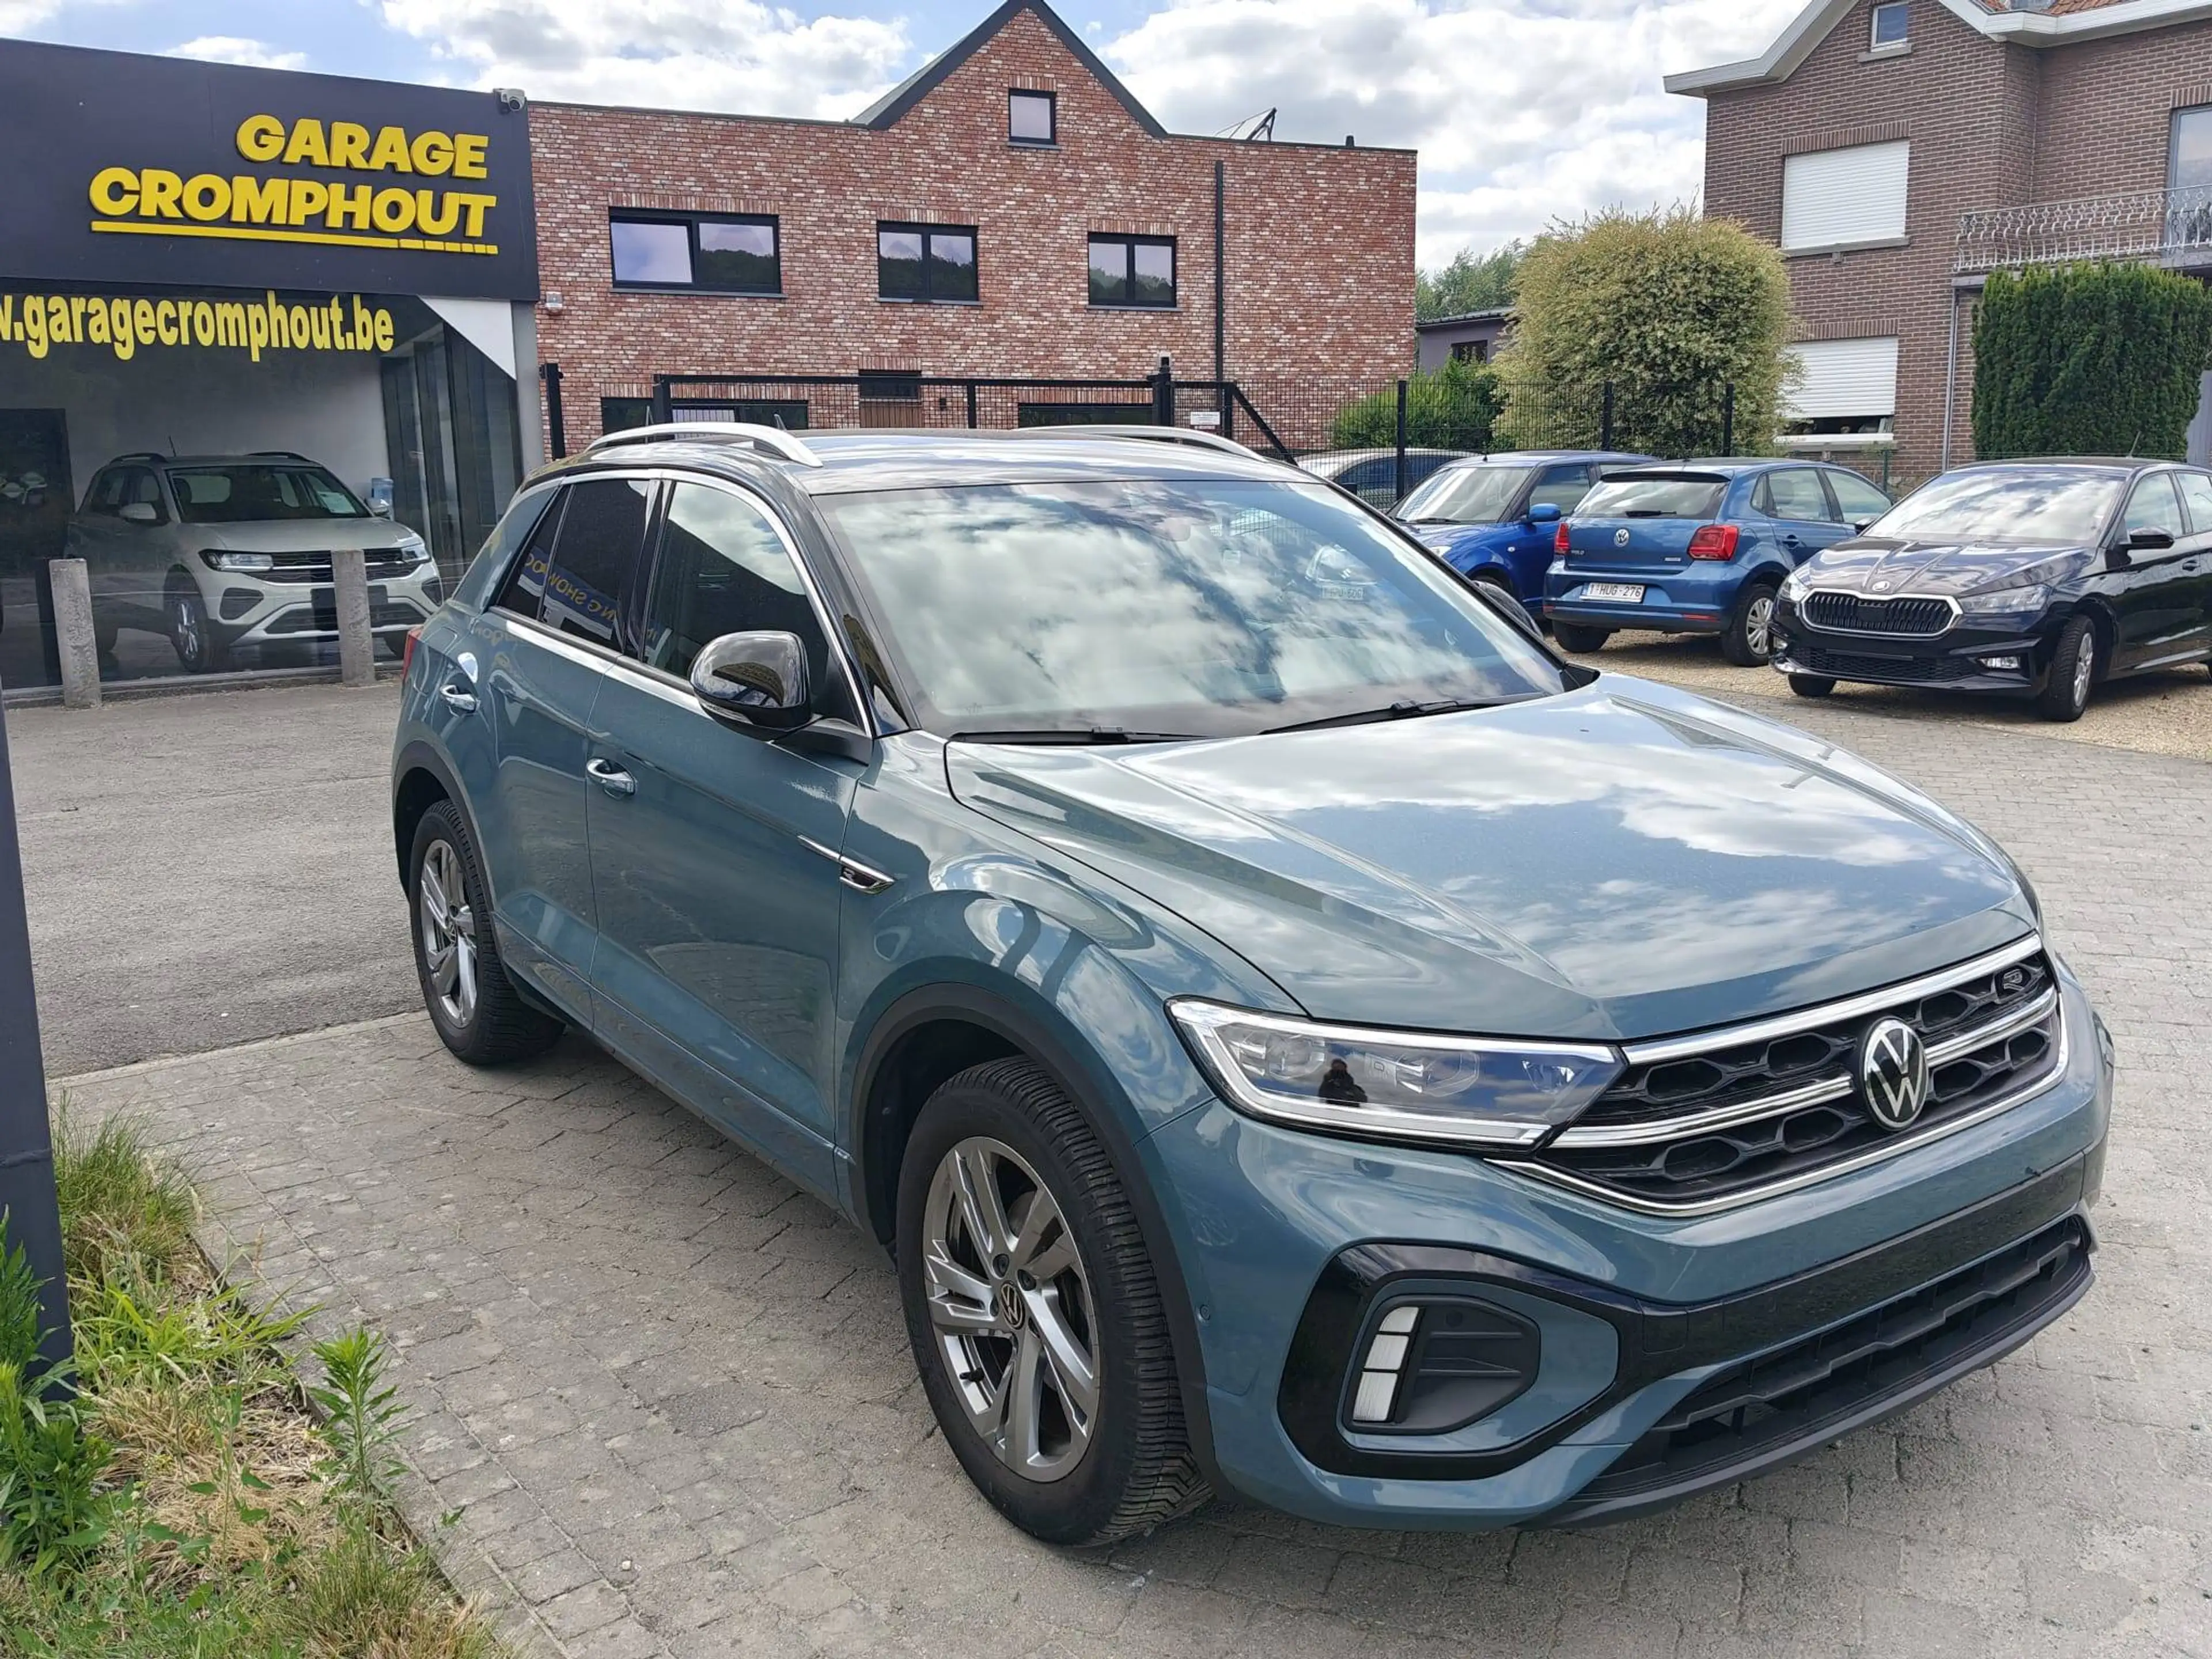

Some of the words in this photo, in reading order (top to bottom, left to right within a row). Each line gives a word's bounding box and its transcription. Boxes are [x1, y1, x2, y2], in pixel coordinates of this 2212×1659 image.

[236, 113, 489, 180] GARAGE
[89, 166, 497, 238] CROMPHOUT
[1589, 584, 1642, 597] 1-HUG-276
[2003, 968, 2025, 991] R
